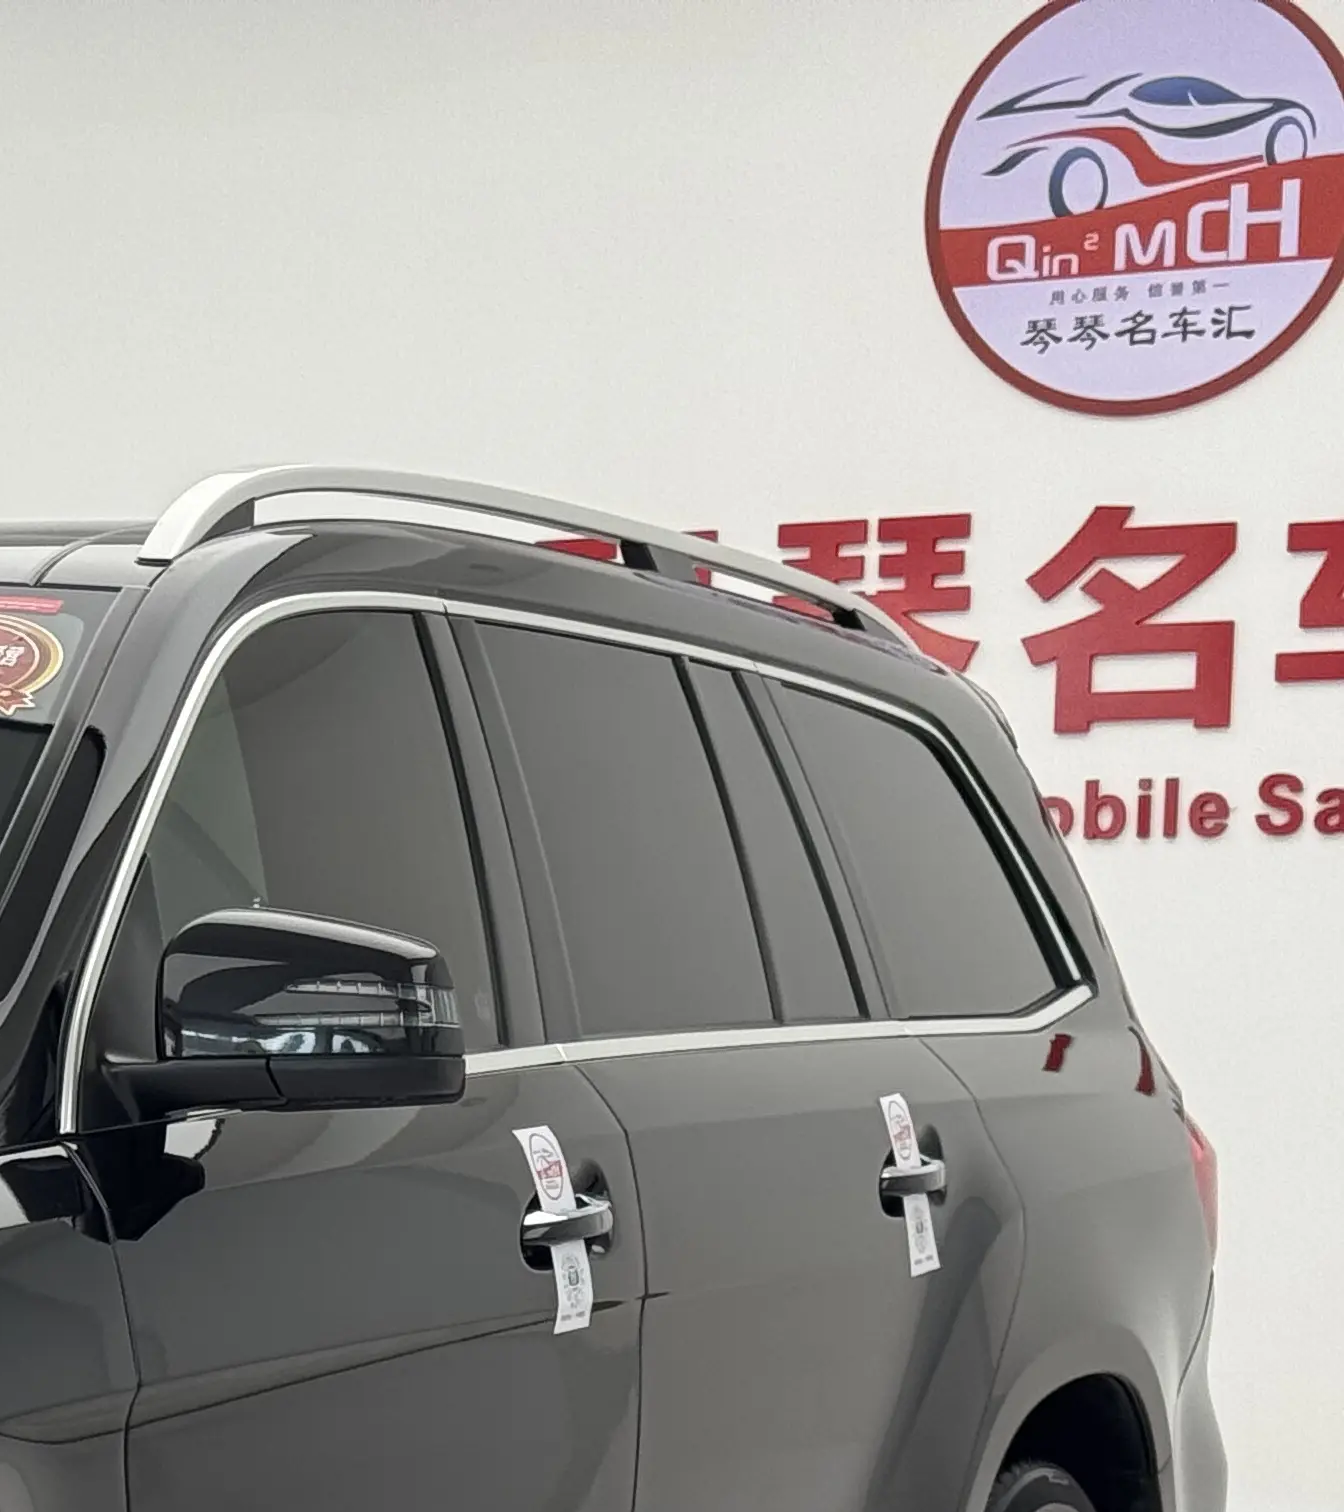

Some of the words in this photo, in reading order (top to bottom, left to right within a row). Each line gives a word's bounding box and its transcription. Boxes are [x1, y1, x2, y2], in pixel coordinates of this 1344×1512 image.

[1018, 304, 1256, 355] 琴琴名车汇
